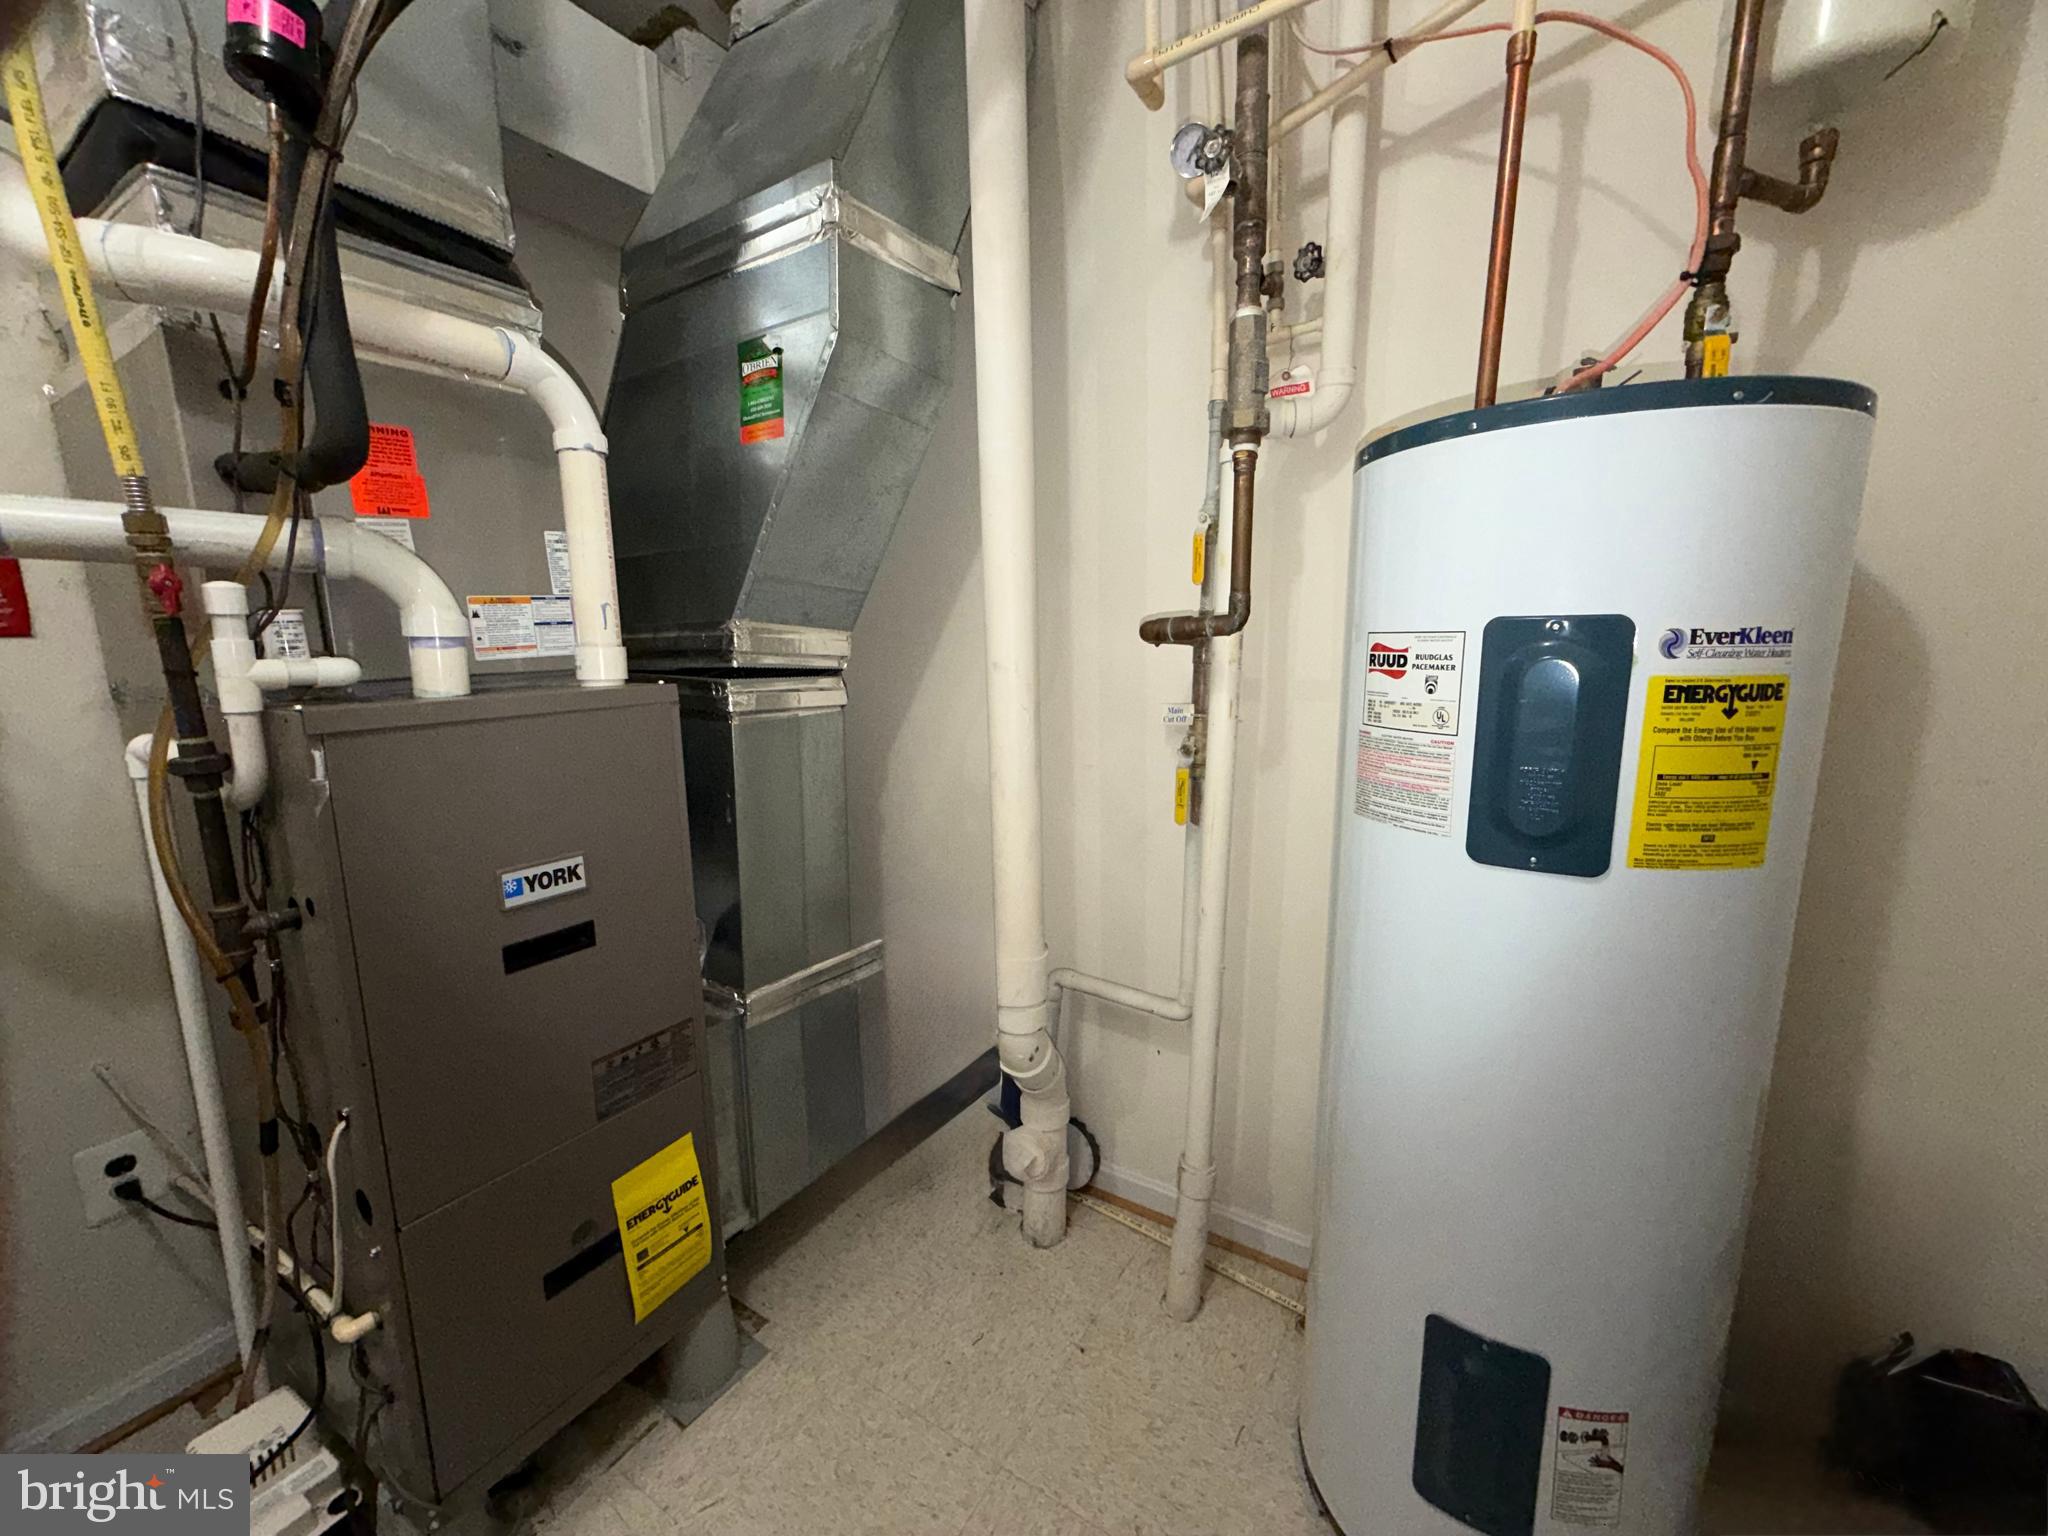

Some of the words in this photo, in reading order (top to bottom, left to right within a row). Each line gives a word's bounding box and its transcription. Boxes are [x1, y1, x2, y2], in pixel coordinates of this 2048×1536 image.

[1272, 383, 1308, 397] WARNING
[1689, 626, 1793, 645] EverKleen
[1369, 653, 1408, 668] RUUD
[1415, 653, 1453, 661] RUUDGLAS
[1412, 663, 1456, 671] PACEMAKER
[1663, 682, 1785, 704] ENERGYGUIDE
[524, 863, 583, 893] YORK
[626, 1174, 700, 1231] ENERGYGUIDE
